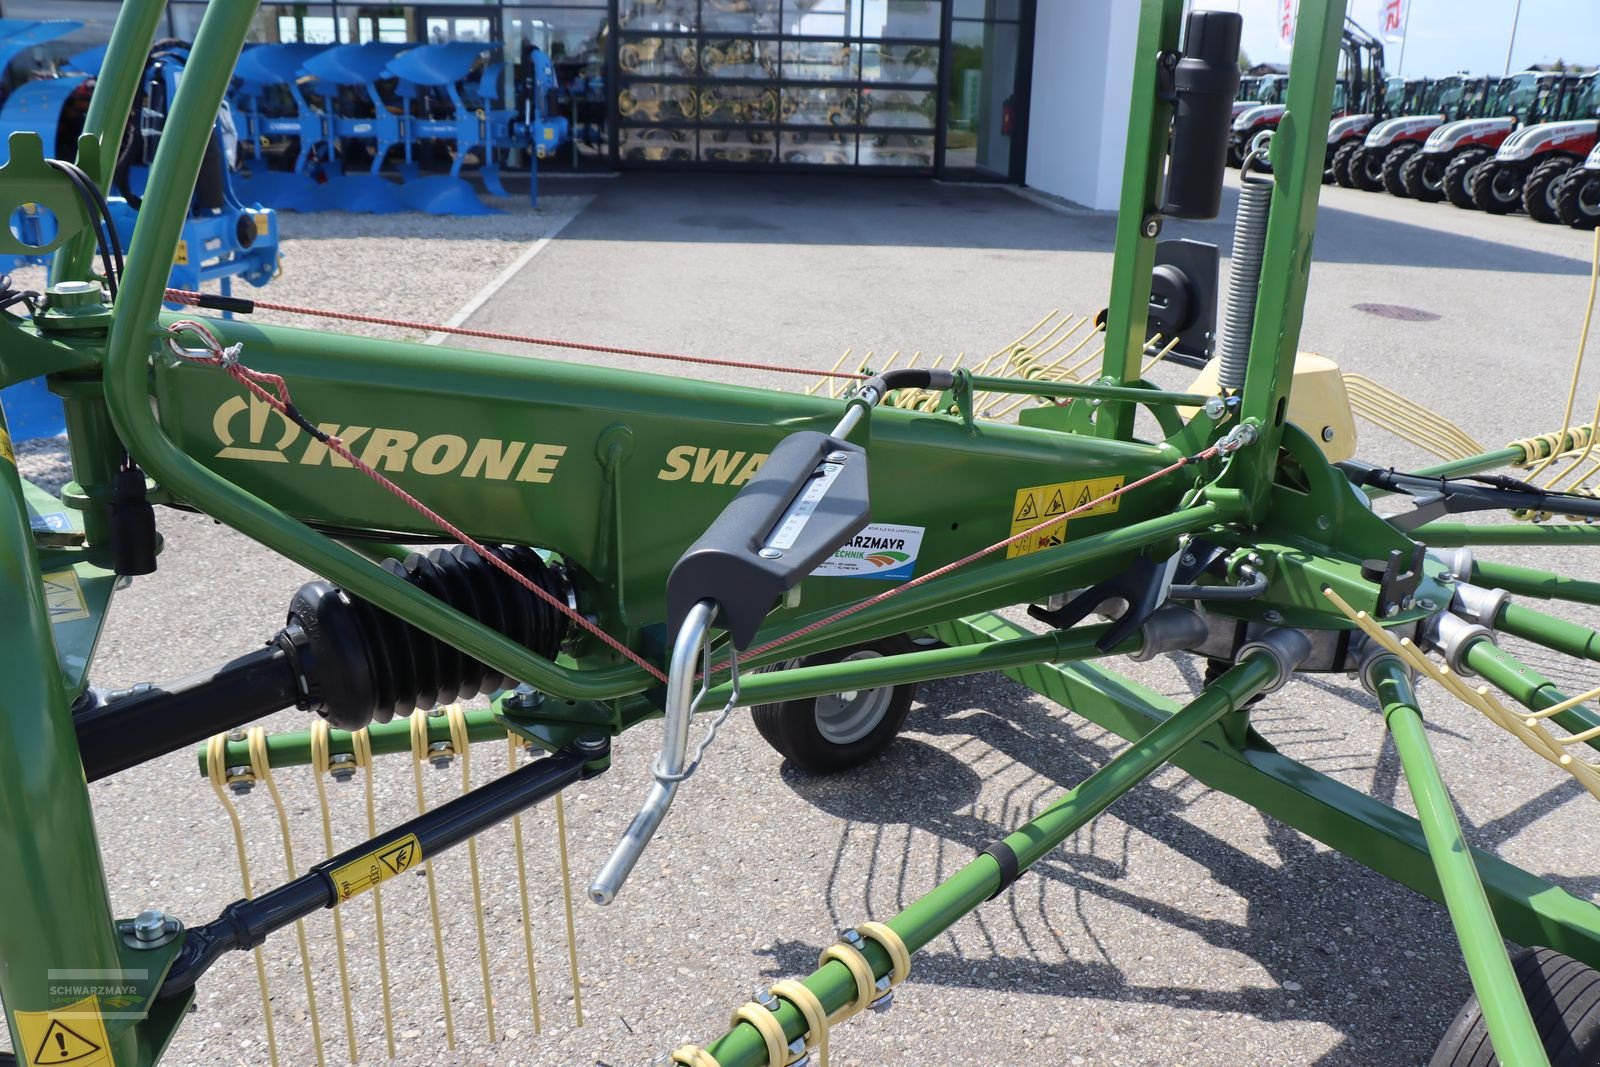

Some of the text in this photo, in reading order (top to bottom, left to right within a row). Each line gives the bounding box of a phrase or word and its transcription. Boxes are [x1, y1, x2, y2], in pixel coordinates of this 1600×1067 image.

[299, 423, 567, 484] KRONE
[658, 445, 769, 485] SWA
[835, 550, 865, 559] ECHNIK
[845, 536, 905, 550] ARZMAYR
